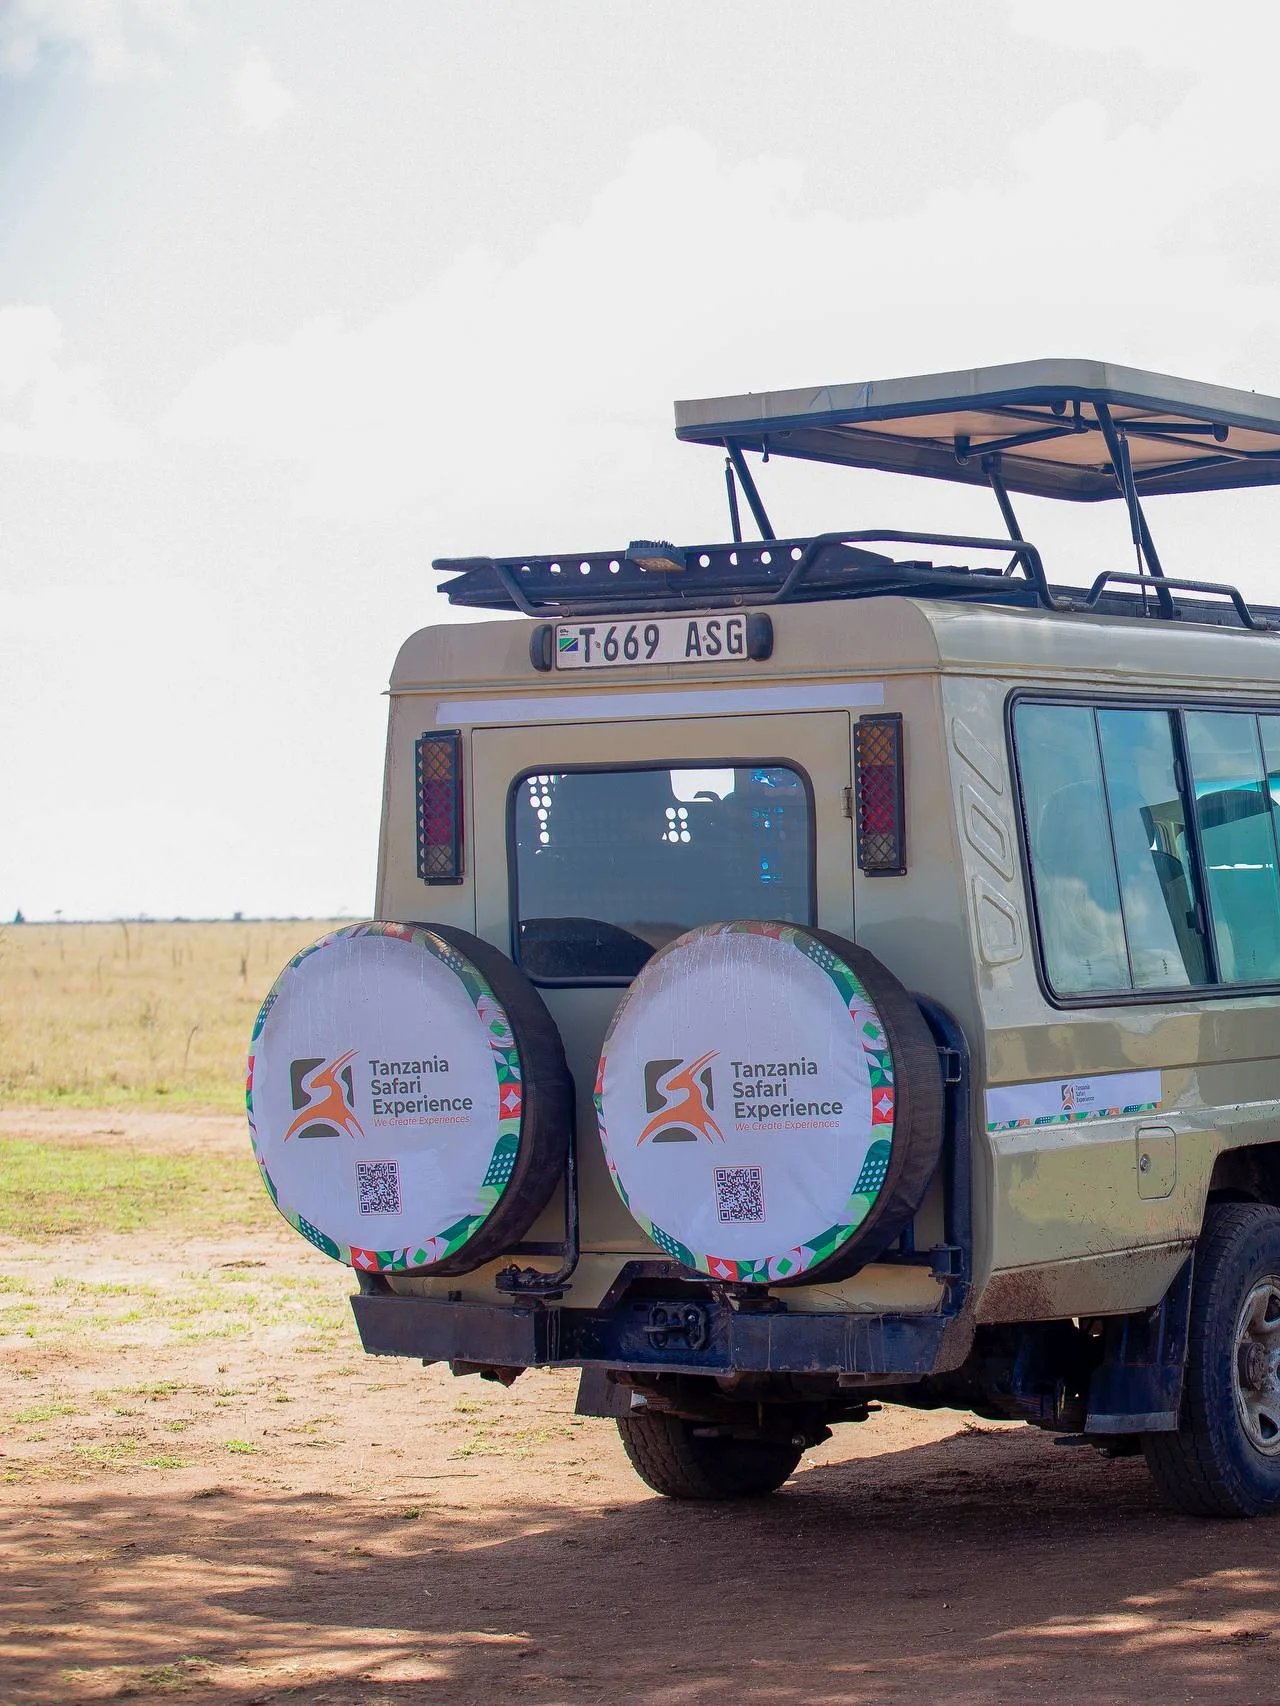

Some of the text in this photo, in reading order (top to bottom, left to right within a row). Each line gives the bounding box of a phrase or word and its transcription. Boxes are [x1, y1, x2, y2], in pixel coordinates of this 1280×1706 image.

[685, 619, 743, 658] ASG
[369, 1055, 449, 1076] Tanzania
[730, 1057, 818, 1078] Tanzania
[371, 1075, 421, 1096] Safari
[732, 1078, 788, 1098] Safari
[373, 1095, 473, 1117] Experience
[734, 1098, 843, 1121] Experience
[374, 1115, 470, 1127] We Create Experiences
[735, 1119, 840, 1131] We Create Experiences
